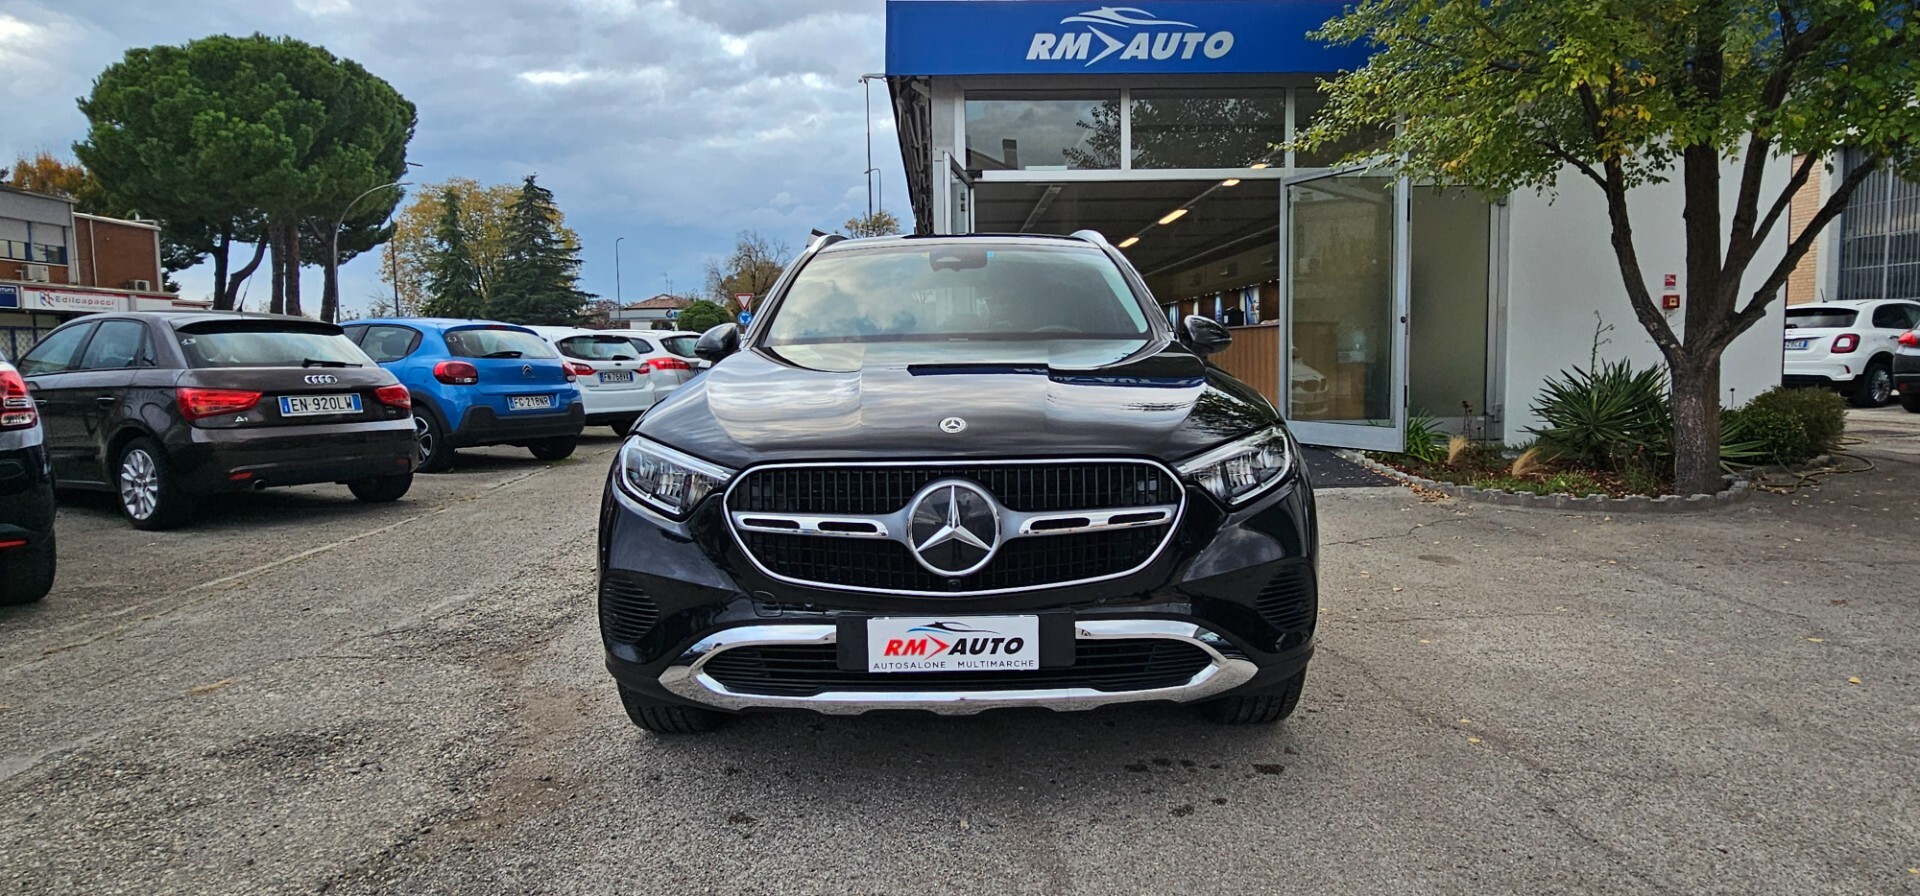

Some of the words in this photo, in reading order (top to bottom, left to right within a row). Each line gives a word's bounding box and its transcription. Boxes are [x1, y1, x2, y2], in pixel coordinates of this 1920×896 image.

[1025, 32, 1092, 61] RM
[1119, 30, 1235, 61] AUTO
[55, 295, 114, 306] Edilcapacci
[884, 639, 928, 657] RM
[947, 637, 1024, 656] AUTO
[873, 661, 946, 670] AUTOSALONE
[957, 659, 1034, 668] MULTIMARCHE
